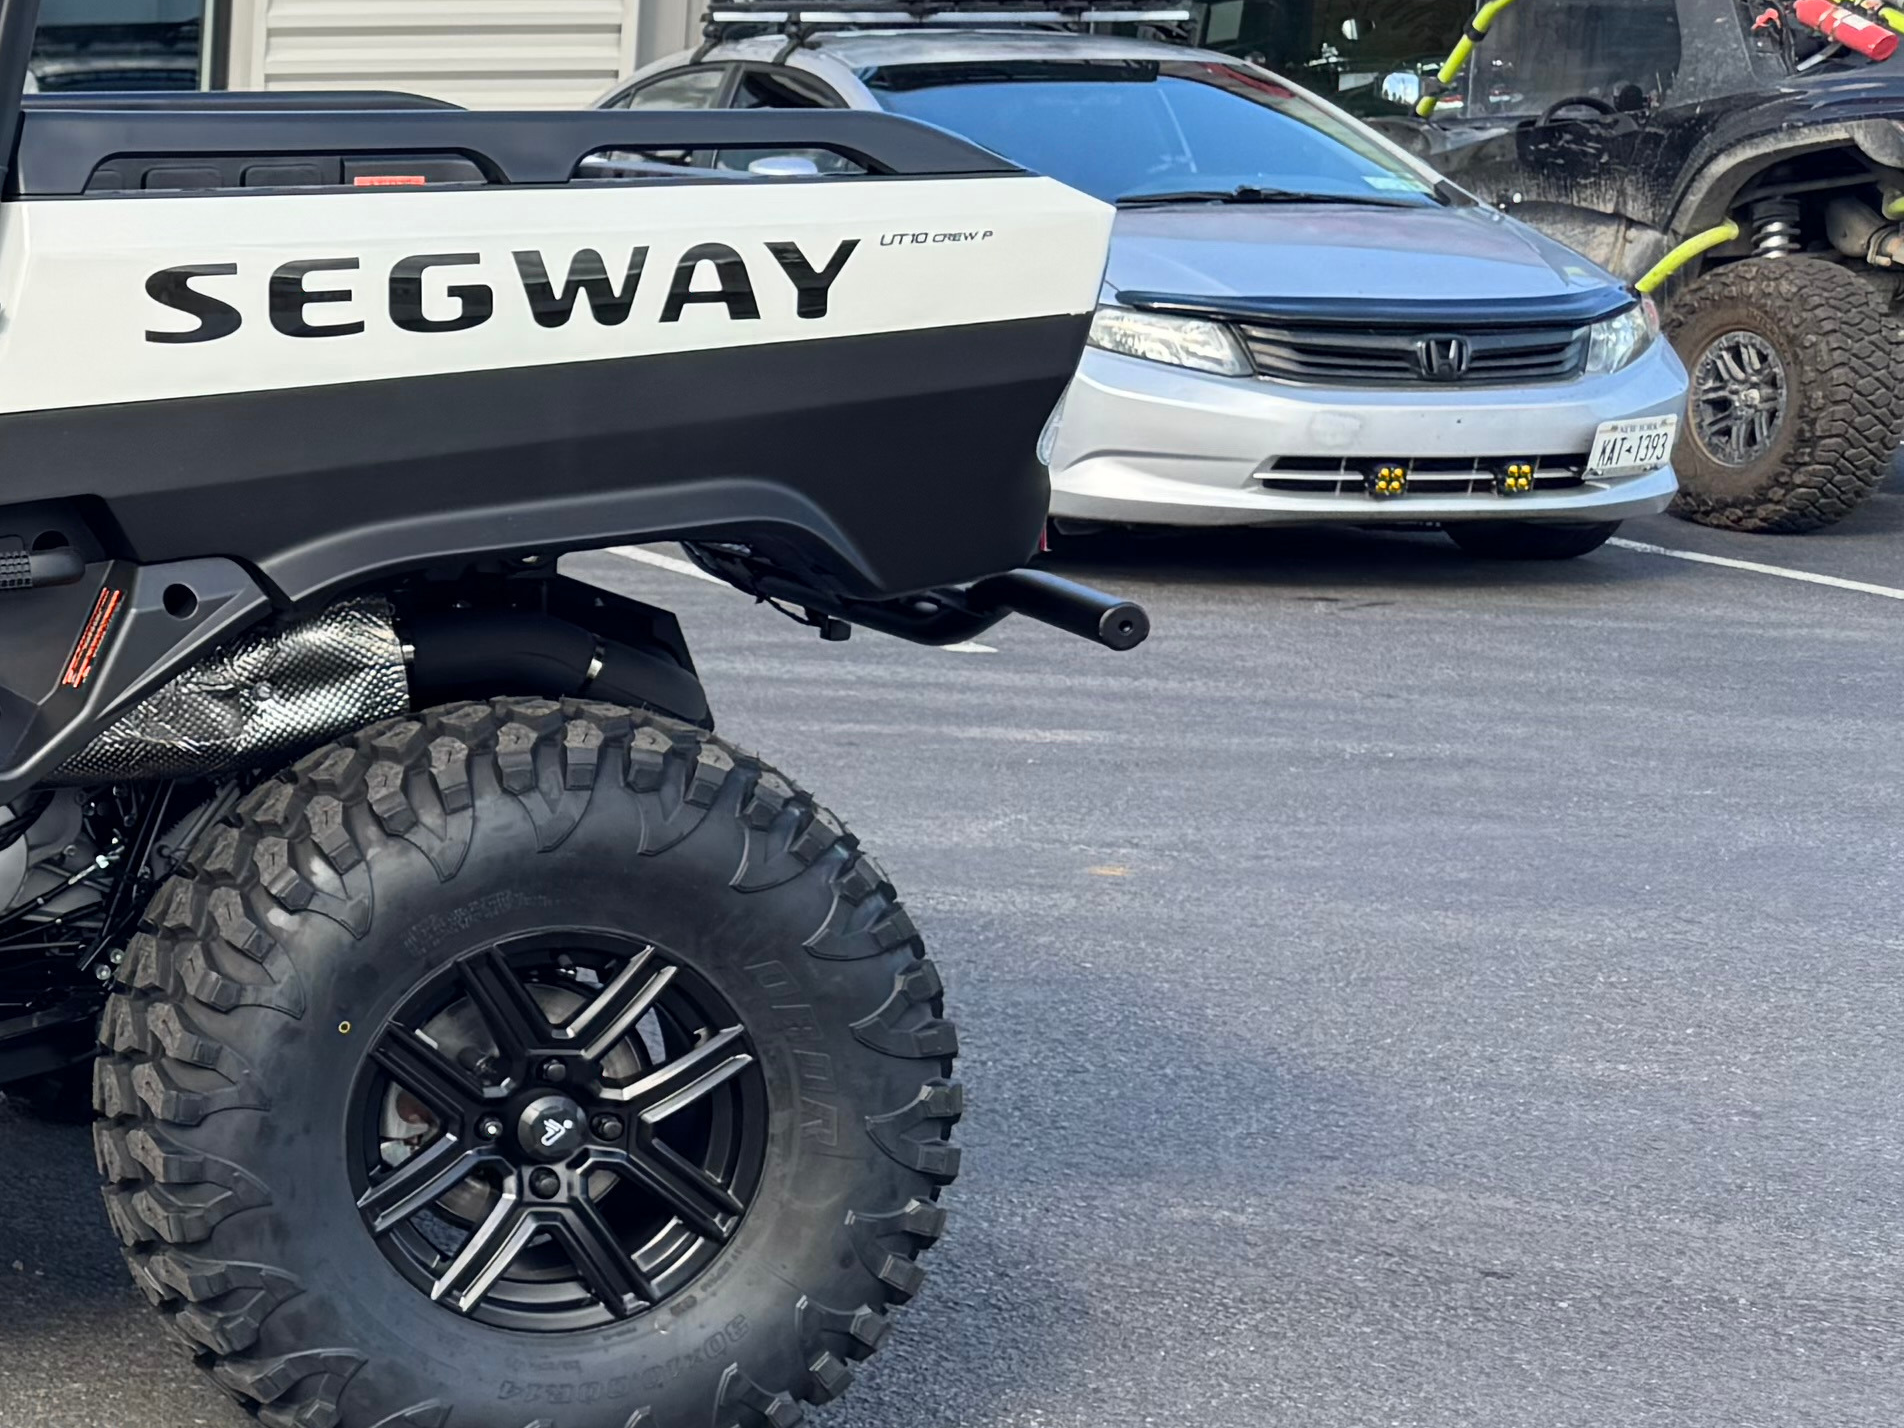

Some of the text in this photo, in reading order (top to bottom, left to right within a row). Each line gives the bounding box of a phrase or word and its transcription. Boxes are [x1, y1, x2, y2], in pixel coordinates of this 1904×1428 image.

[880, 232, 929, 247] UT10
[982, 231, 994, 241] P
[145, 239, 860, 344] SEGWAY
